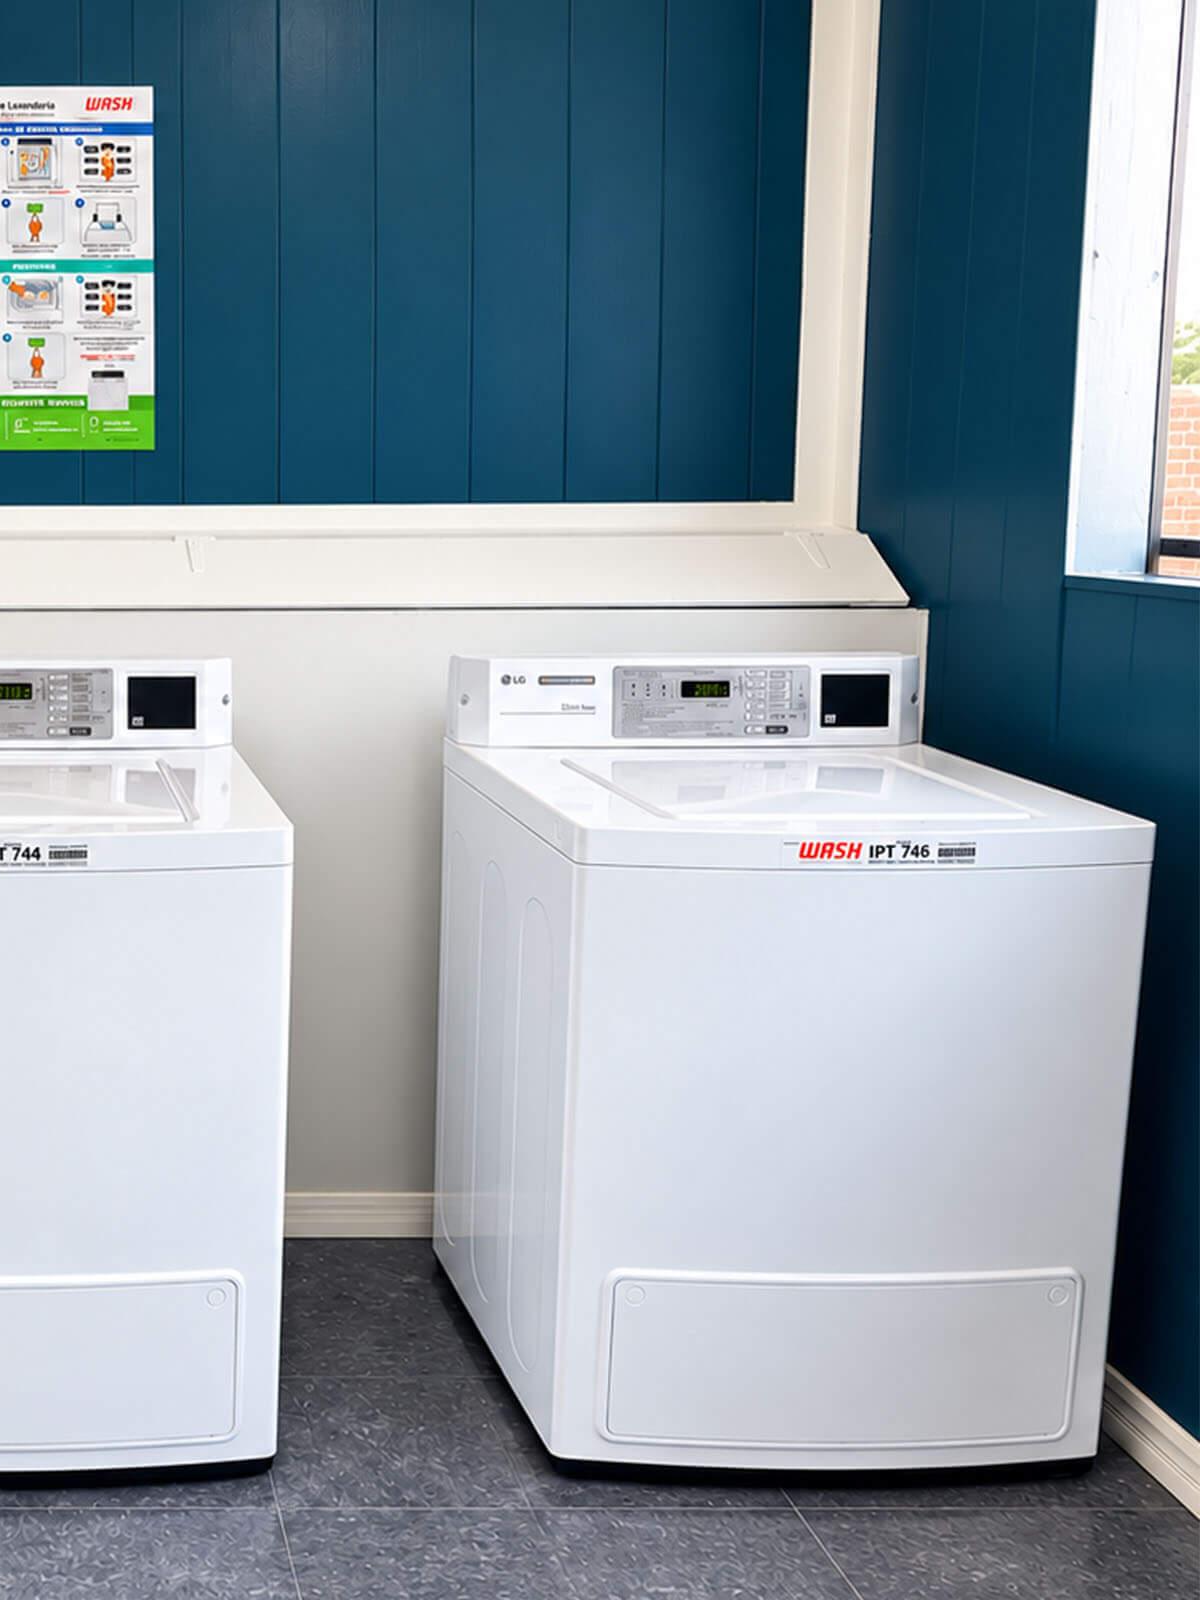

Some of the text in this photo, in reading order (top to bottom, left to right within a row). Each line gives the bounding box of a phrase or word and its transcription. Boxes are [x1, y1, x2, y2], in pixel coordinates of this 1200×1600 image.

[85, 96, 134, 112] WASH
[512, 675, 526, 685] LG
[12, 846, 41, 861] 744
[799, 842, 930, 859] WASH IPT 746
